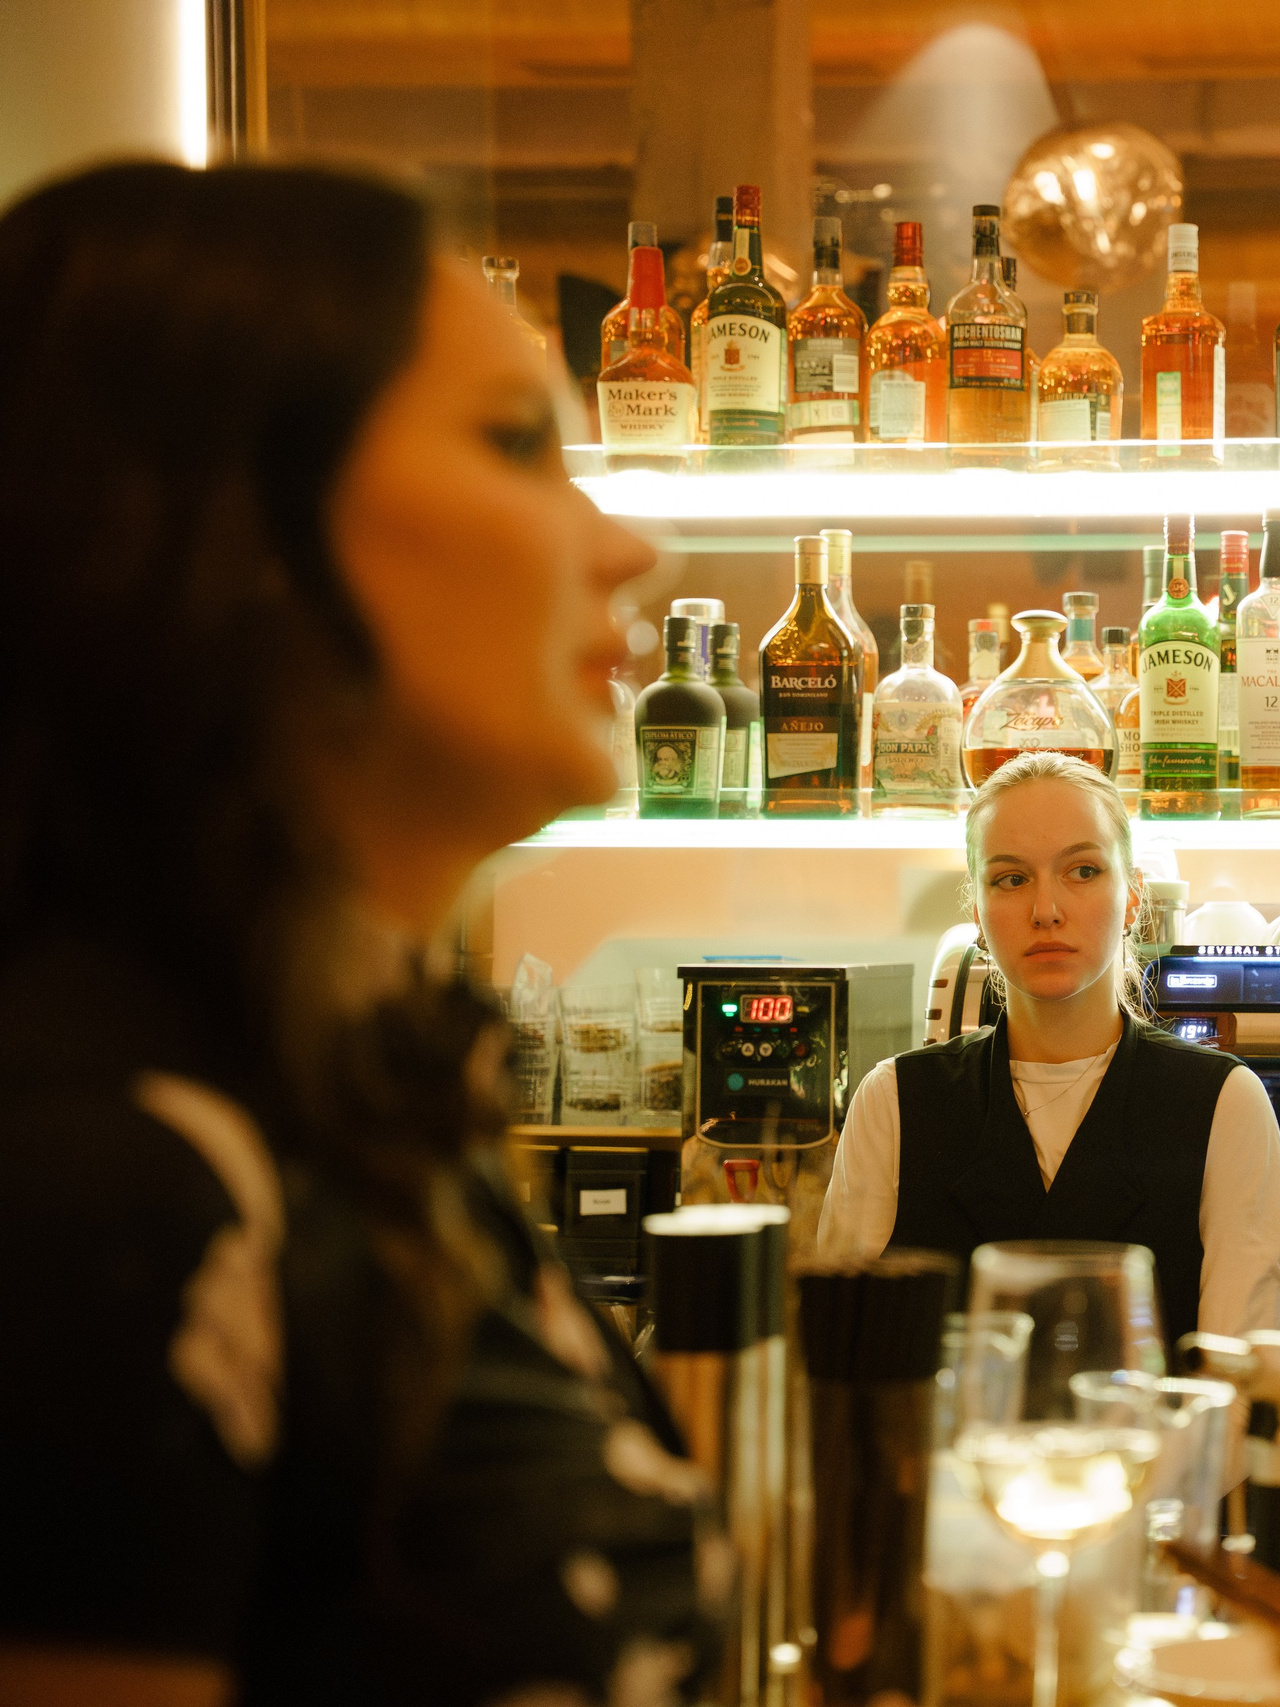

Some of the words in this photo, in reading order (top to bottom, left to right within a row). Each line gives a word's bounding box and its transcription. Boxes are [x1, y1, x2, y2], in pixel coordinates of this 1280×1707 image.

[608, 388, 678, 401] Maker's
[626, 404, 677, 416] Mark
[1143, 649, 1213, 673] JAMESON
[771, 674, 837, 690] BARCELÓ
[1265, 696, 1278, 708] 12
[781, 720, 824, 731] AÑEJO
[1000, 712, 1064, 731] Zacapa
[879, 743, 898, 752] DON
[901, 743, 928, 753] PAPA
[1198, 945, 1260, 955] SEVERAL
[750, 997, 792, 1021] 100
